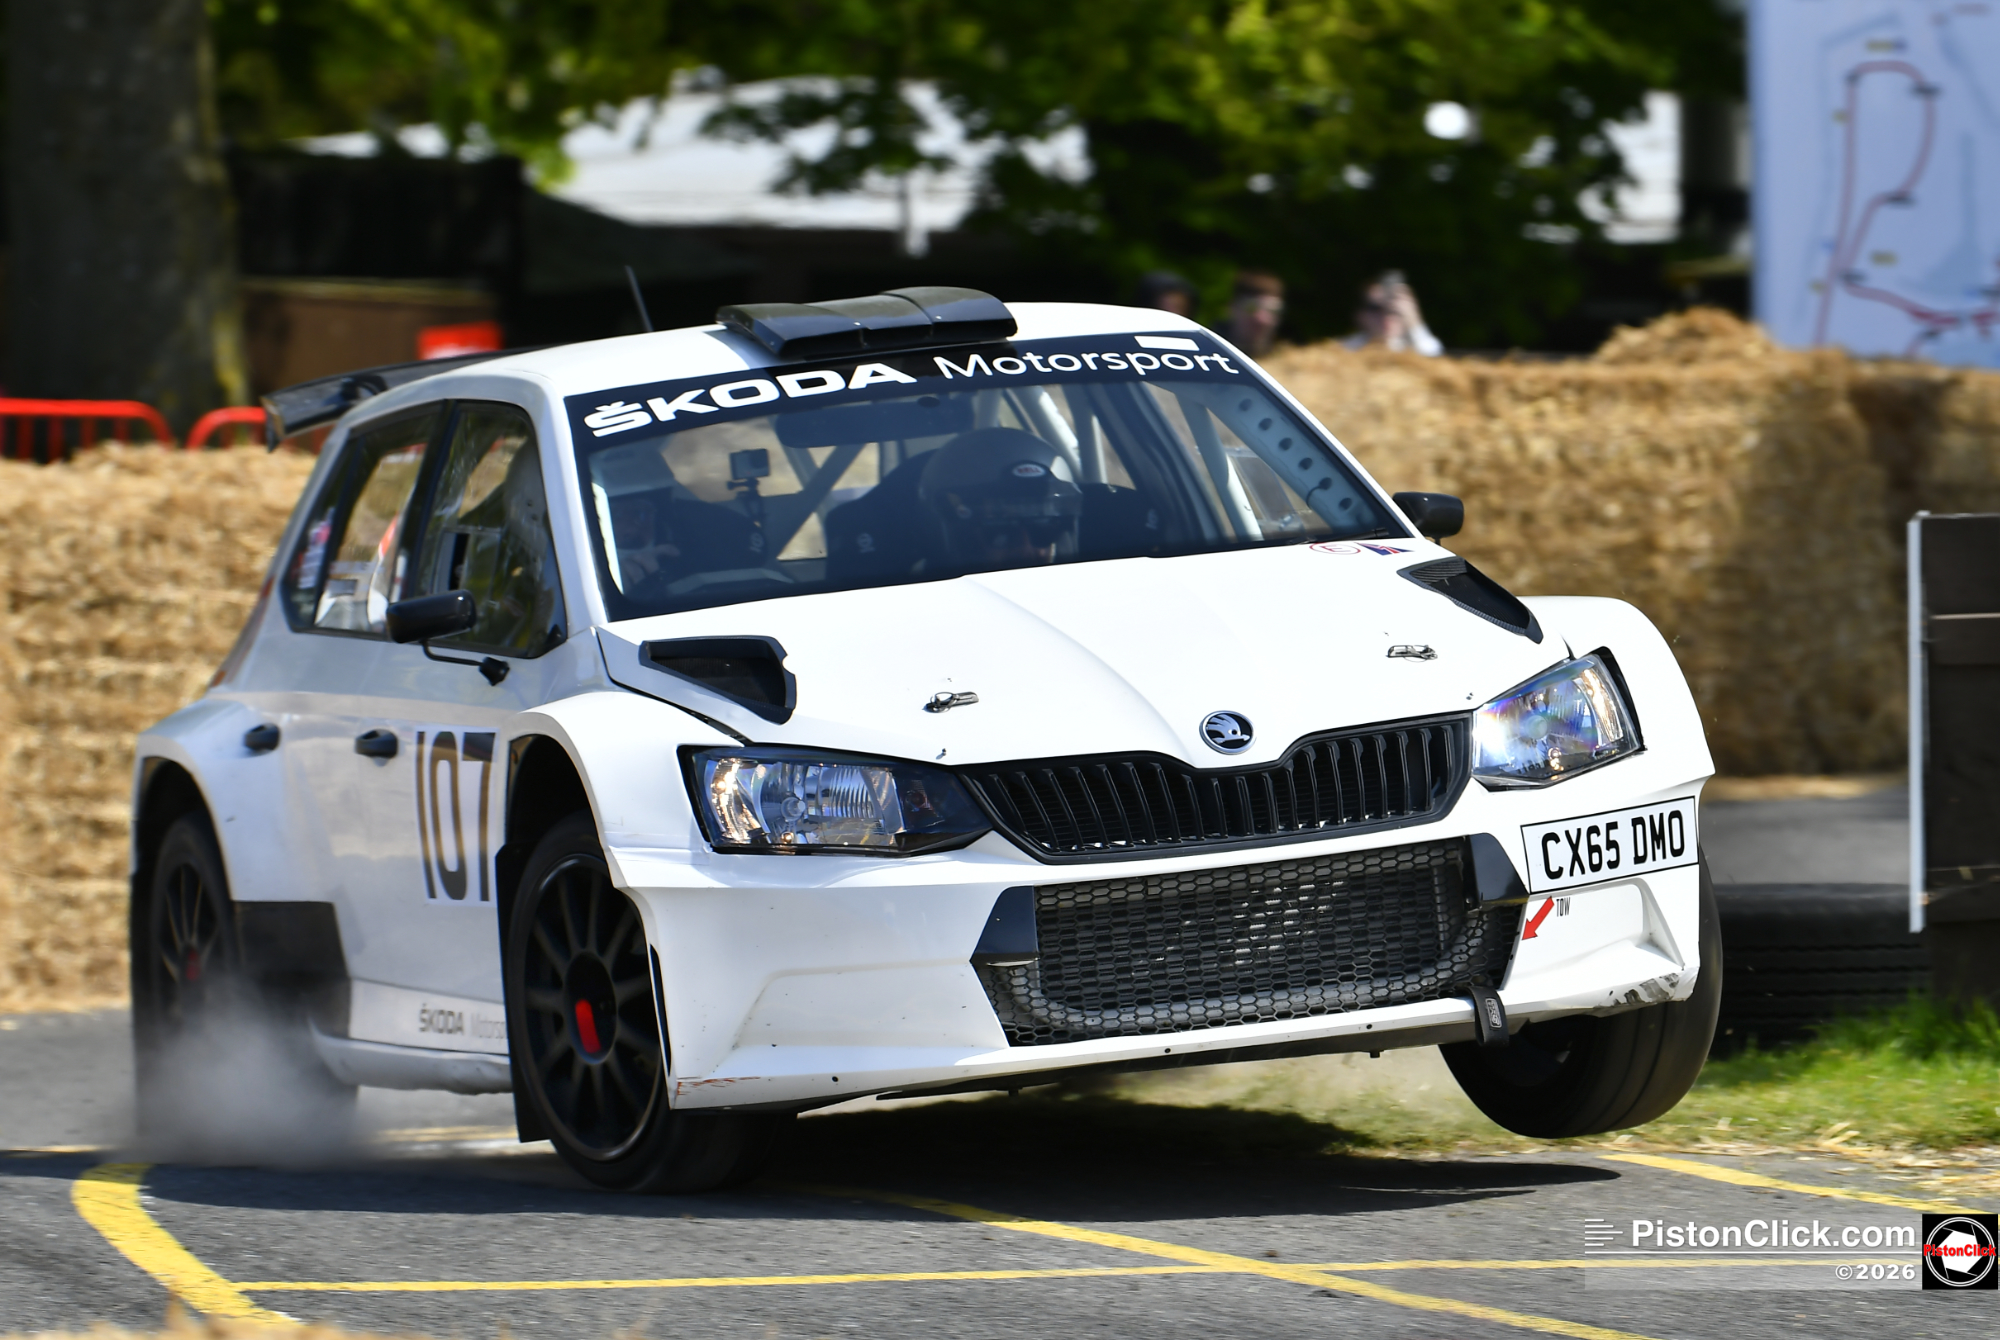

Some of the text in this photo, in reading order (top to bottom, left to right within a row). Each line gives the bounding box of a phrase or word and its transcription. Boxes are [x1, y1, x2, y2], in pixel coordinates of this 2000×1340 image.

[584, 351, 1239, 438] ŠKODA Motorsport
[416, 731, 496, 902] 107
[1541, 809, 1685, 880] CX65 DMO
[1556, 897, 1571, 917] TOW
[418, 1002, 465, 1036] ŠKODA
